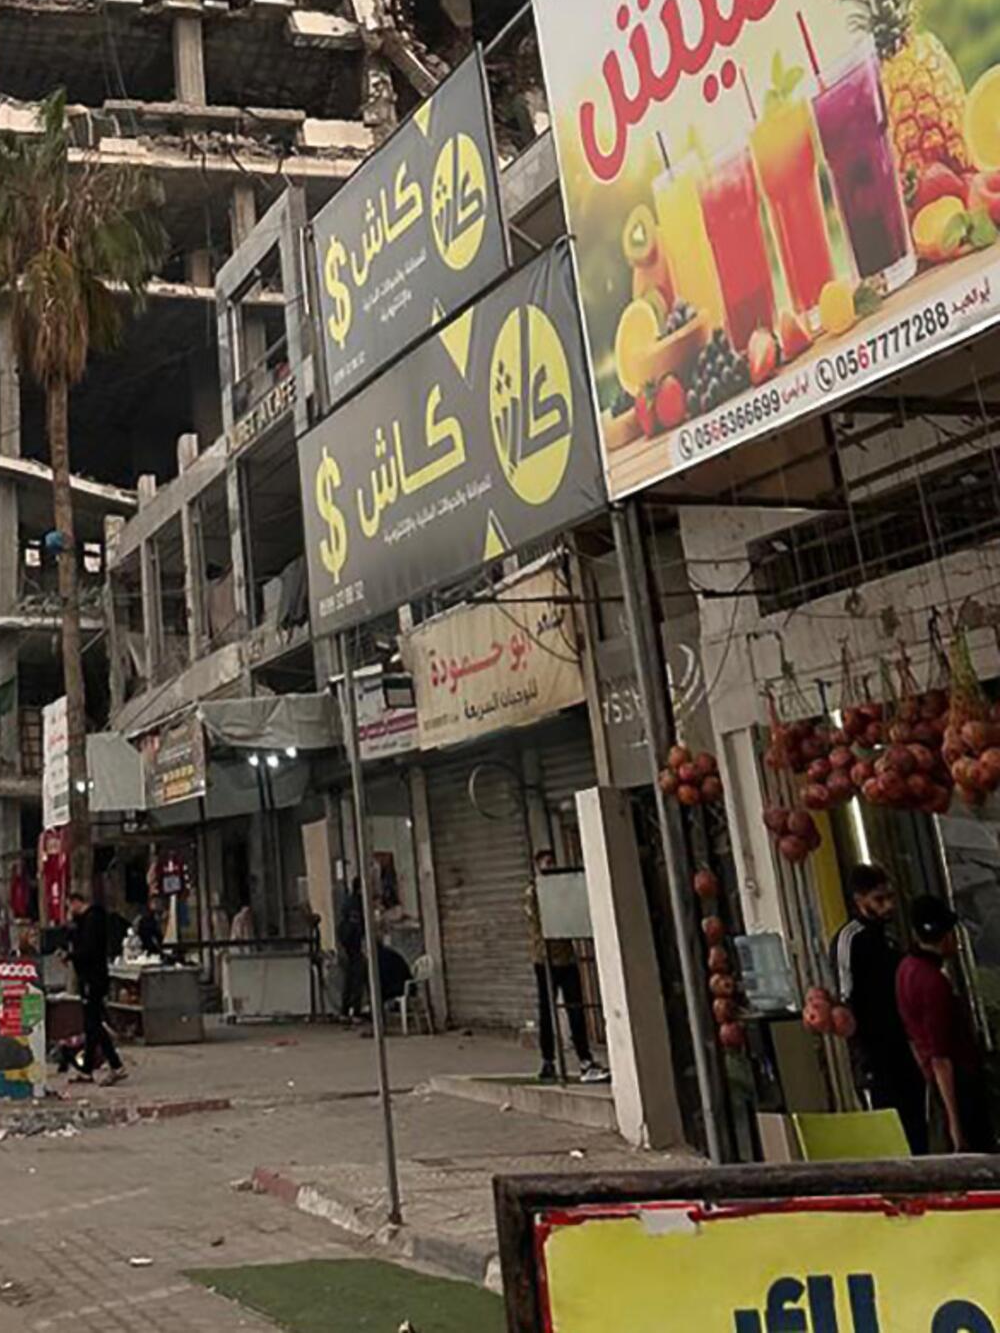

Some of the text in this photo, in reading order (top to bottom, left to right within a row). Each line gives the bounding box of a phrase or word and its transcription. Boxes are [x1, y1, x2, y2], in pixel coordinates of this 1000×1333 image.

[351, 160, 424, 287] كاش
[836, 301, 950, 380] 0567777288
[355, 382, 467, 539] كاش
